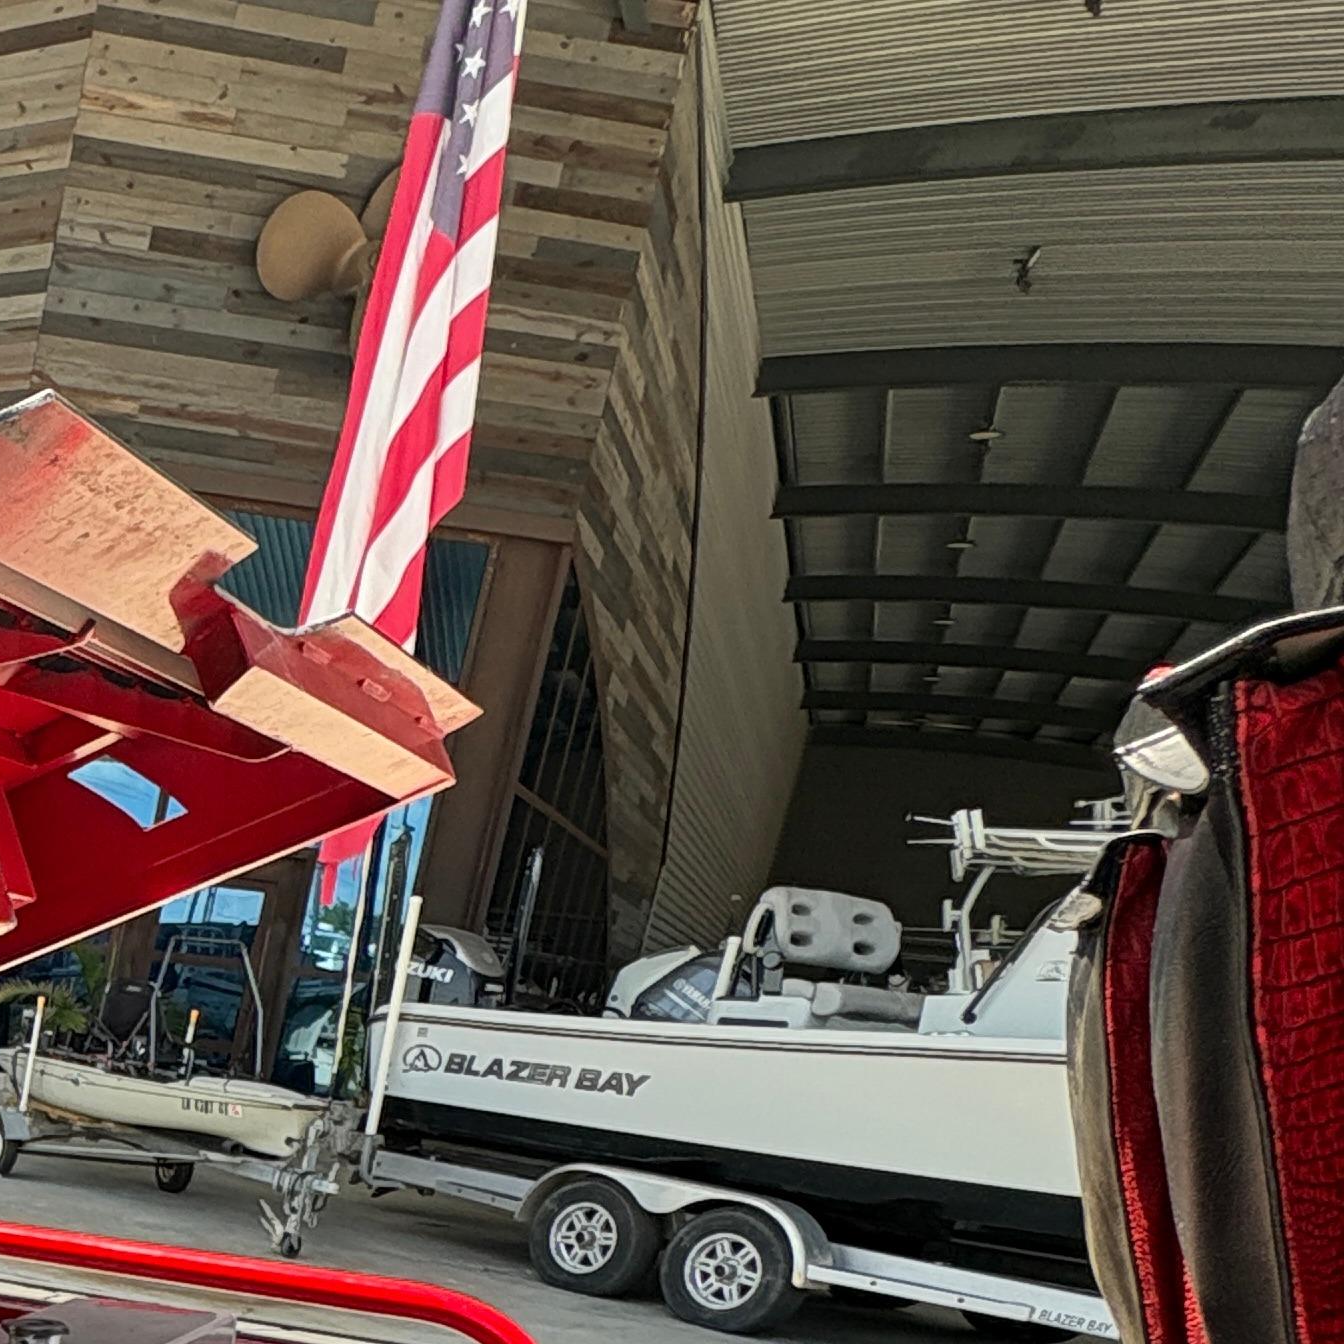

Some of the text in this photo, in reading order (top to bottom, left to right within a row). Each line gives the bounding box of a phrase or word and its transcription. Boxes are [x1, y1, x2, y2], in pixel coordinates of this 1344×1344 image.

[444, 1053, 651, 1097] BLAZER BAY
[1038, 1309, 1113, 1333] BLAZER BAY
